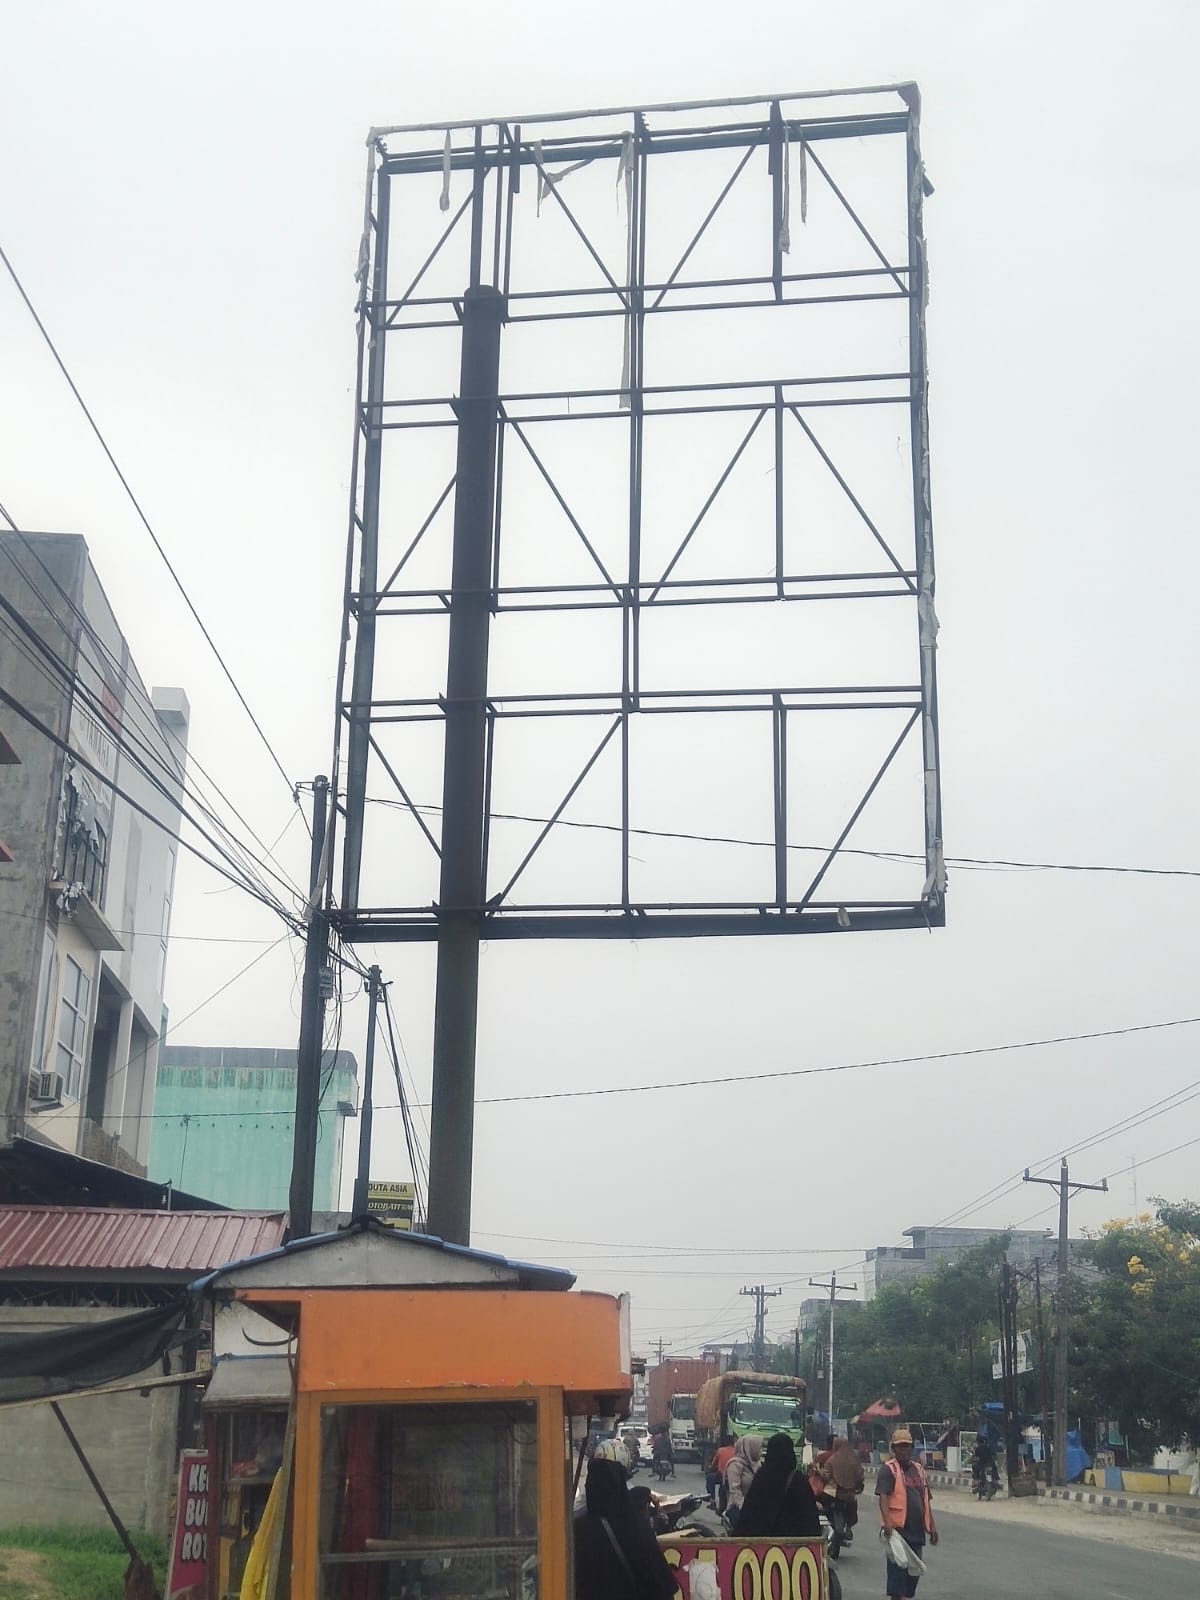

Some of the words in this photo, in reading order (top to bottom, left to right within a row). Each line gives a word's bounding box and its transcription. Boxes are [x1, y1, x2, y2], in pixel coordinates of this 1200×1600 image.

[390, 1184, 408, 1193] ASIA
[188, 1463, 208, 1493] KE
[185, 1497, 208, 1527] BU
